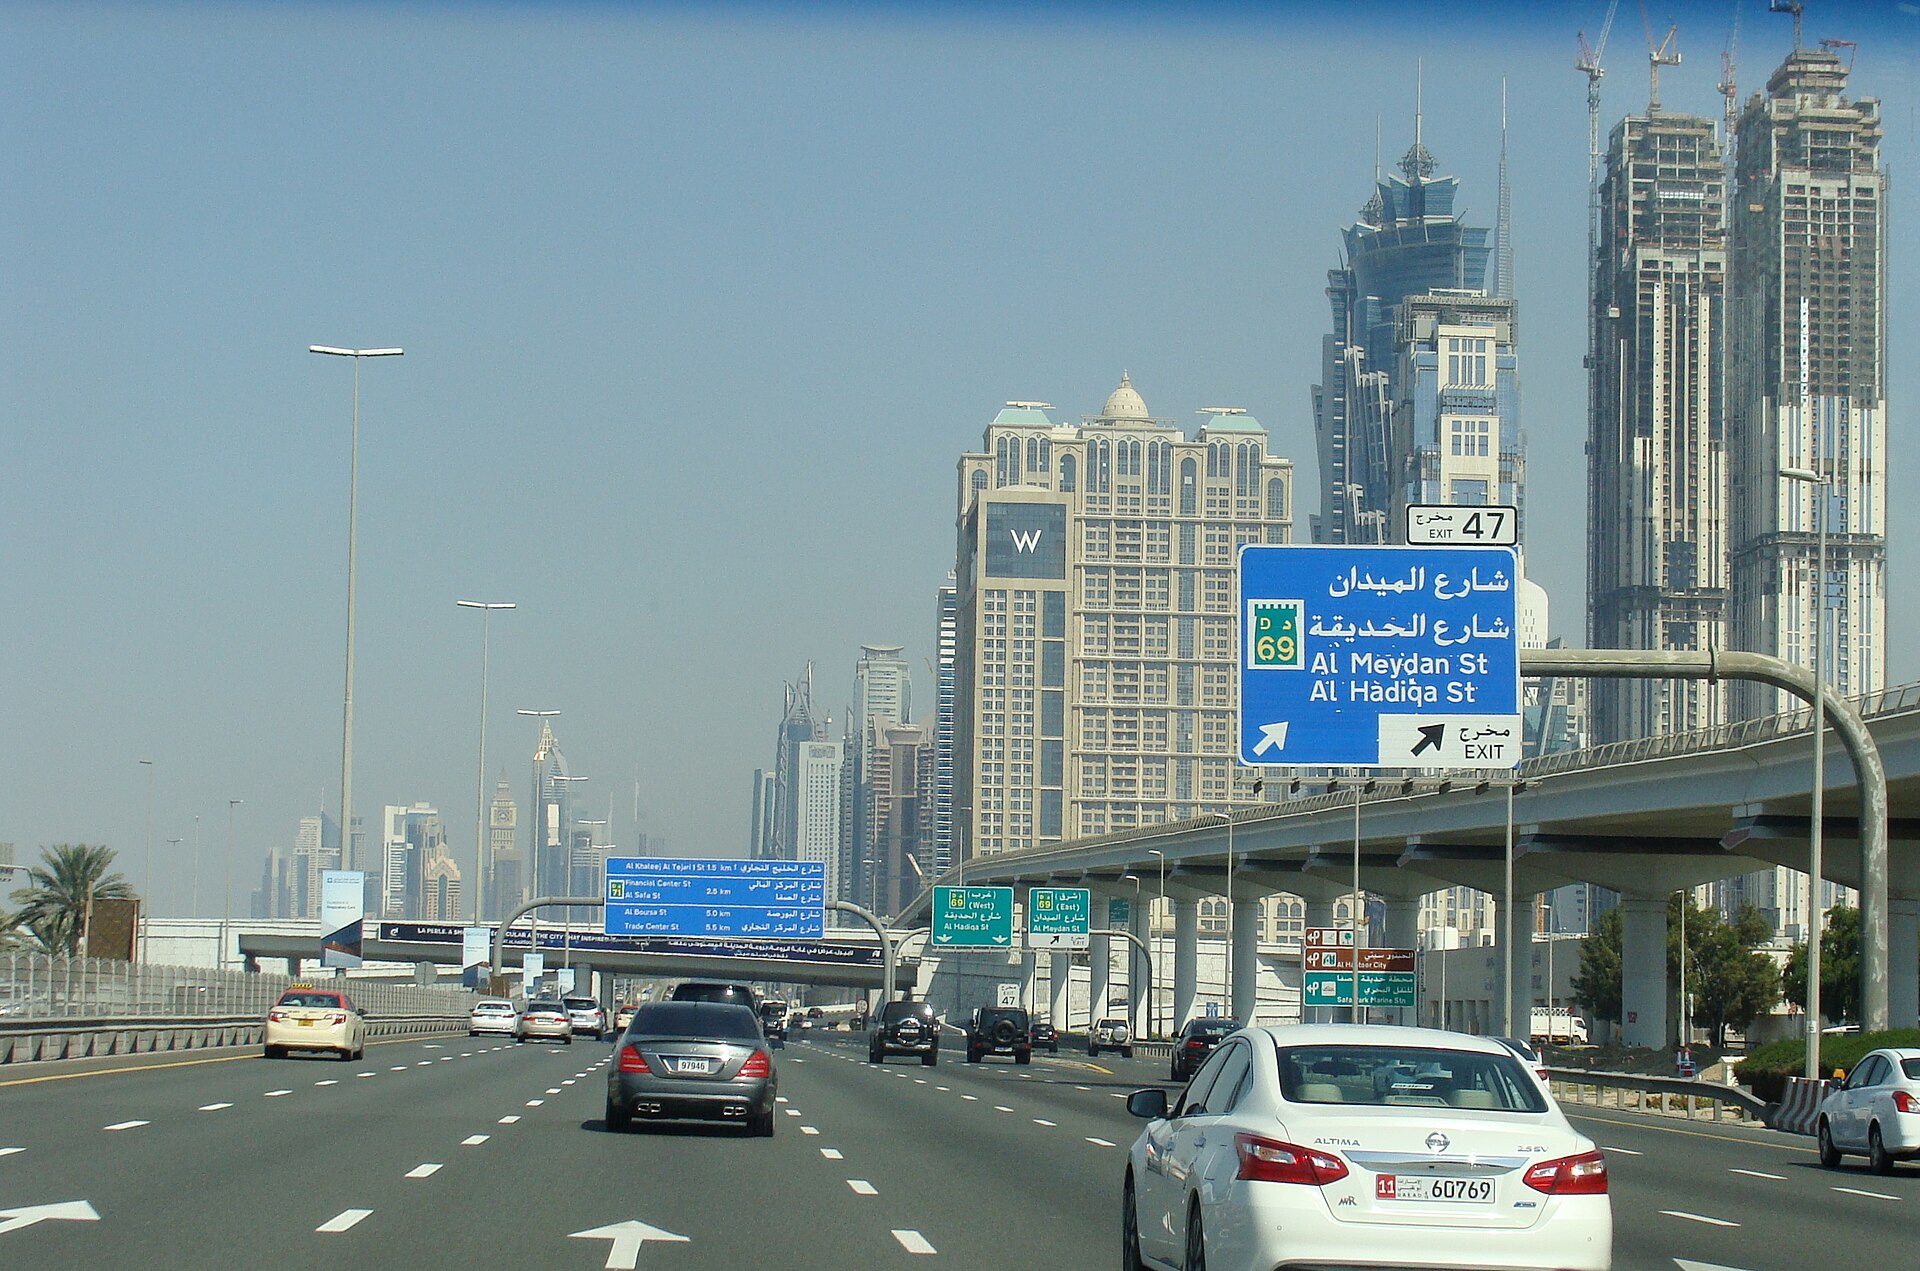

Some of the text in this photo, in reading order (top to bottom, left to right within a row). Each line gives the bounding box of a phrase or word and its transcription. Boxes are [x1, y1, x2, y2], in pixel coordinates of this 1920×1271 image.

[1416, 512, 1453, 525] مخرج
[1462, 512, 1505, 539] 47
[1429, 529, 1454, 539] EXIT
[1010, 529, 1042, 554] W
[1329, 565, 1510, 600] شارع الميدان
[1260, 617, 1271, 630] D
[1433, 612, 1510, 646] شارع
[1257, 635, 1295, 662] 69
[1311, 652, 1488, 679] Al Meydan St
[1309, 680, 1476, 707] Al Hadiqa St
[1459, 724, 1511, 742] مخرج
[1465, 744, 1504, 759] EXIT
[635, 862, 661, 871] Khaleej
[740, 863, 770, 873] التجاري
[772, 864, 799, 874] الخليج
[801, 866, 823, 875] شارع
[625, 879, 656, 888] Financial
[657, 880, 682, 888] Center
[748, 880, 822, 891] شارع المركز المالي
[635, 892, 652, 900] Safa
[775, 893, 821, 903] شارع الصفا
[951, 899, 964, 907] 69
[968, 901, 995, 910] (West)
[1039, 901, 1051, 909] 69
[1056, 903, 1080, 911] (East)
[766, 910, 821, 920] شارع البورصة
[944, 911, 1001, 922] شارع الحديقة
[1033, 913, 1086, 923] شارع الميدان
[624, 922, 644, 930] Trade
[645, 922, 670, 931] Center
[741, 922, 821, 934] شارع المركز التجاري
[953, 923, 980, 931] Hadiqa
[1043, 925, 1070, 933] Meydan
[1373, 961, 1387, 969] City
[1002, 996, 1015, 1005] 47
[1313, 1138, 1360, 1147] ALTIMA
[1378, 1180, 1395, 1194] 11
[1432, 1180, 1490, 1199] 60769
